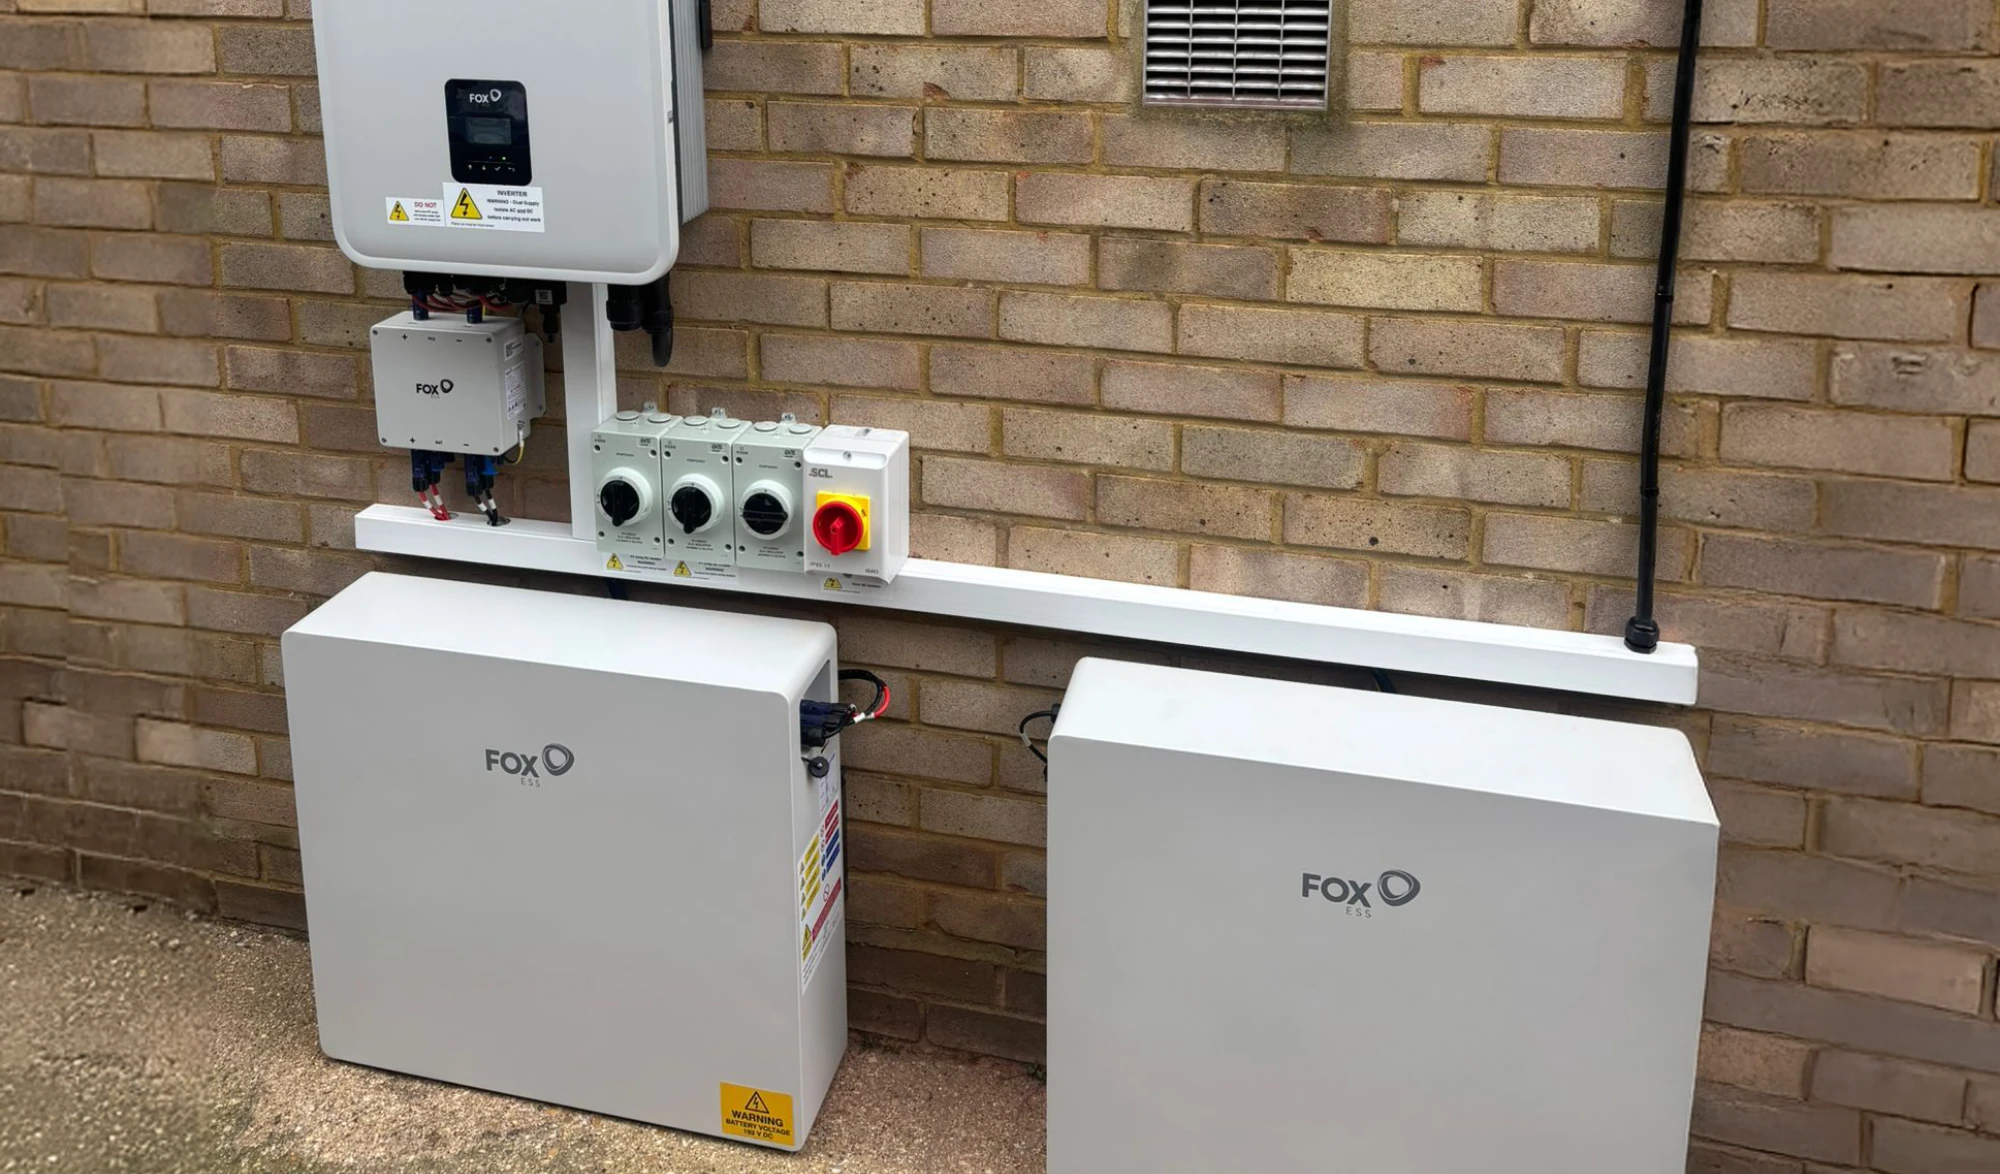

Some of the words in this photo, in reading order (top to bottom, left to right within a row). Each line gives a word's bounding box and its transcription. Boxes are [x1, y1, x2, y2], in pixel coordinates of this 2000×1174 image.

[469, 93, 489, 103] FOX
[416, 383, 439, 395] FOX
[485, 748, 540, 778] FOX
[520, 778, 540, 787] ESS
[1302, 872, 1372, 908] FOX
[1346, 906, 1371, 918] ESS
[731, 1110, 783, 1127] WARNING
[725, 1118, 758, 1129] BATTERY
[758, 1124, 791, 1136] VOLTAGE
